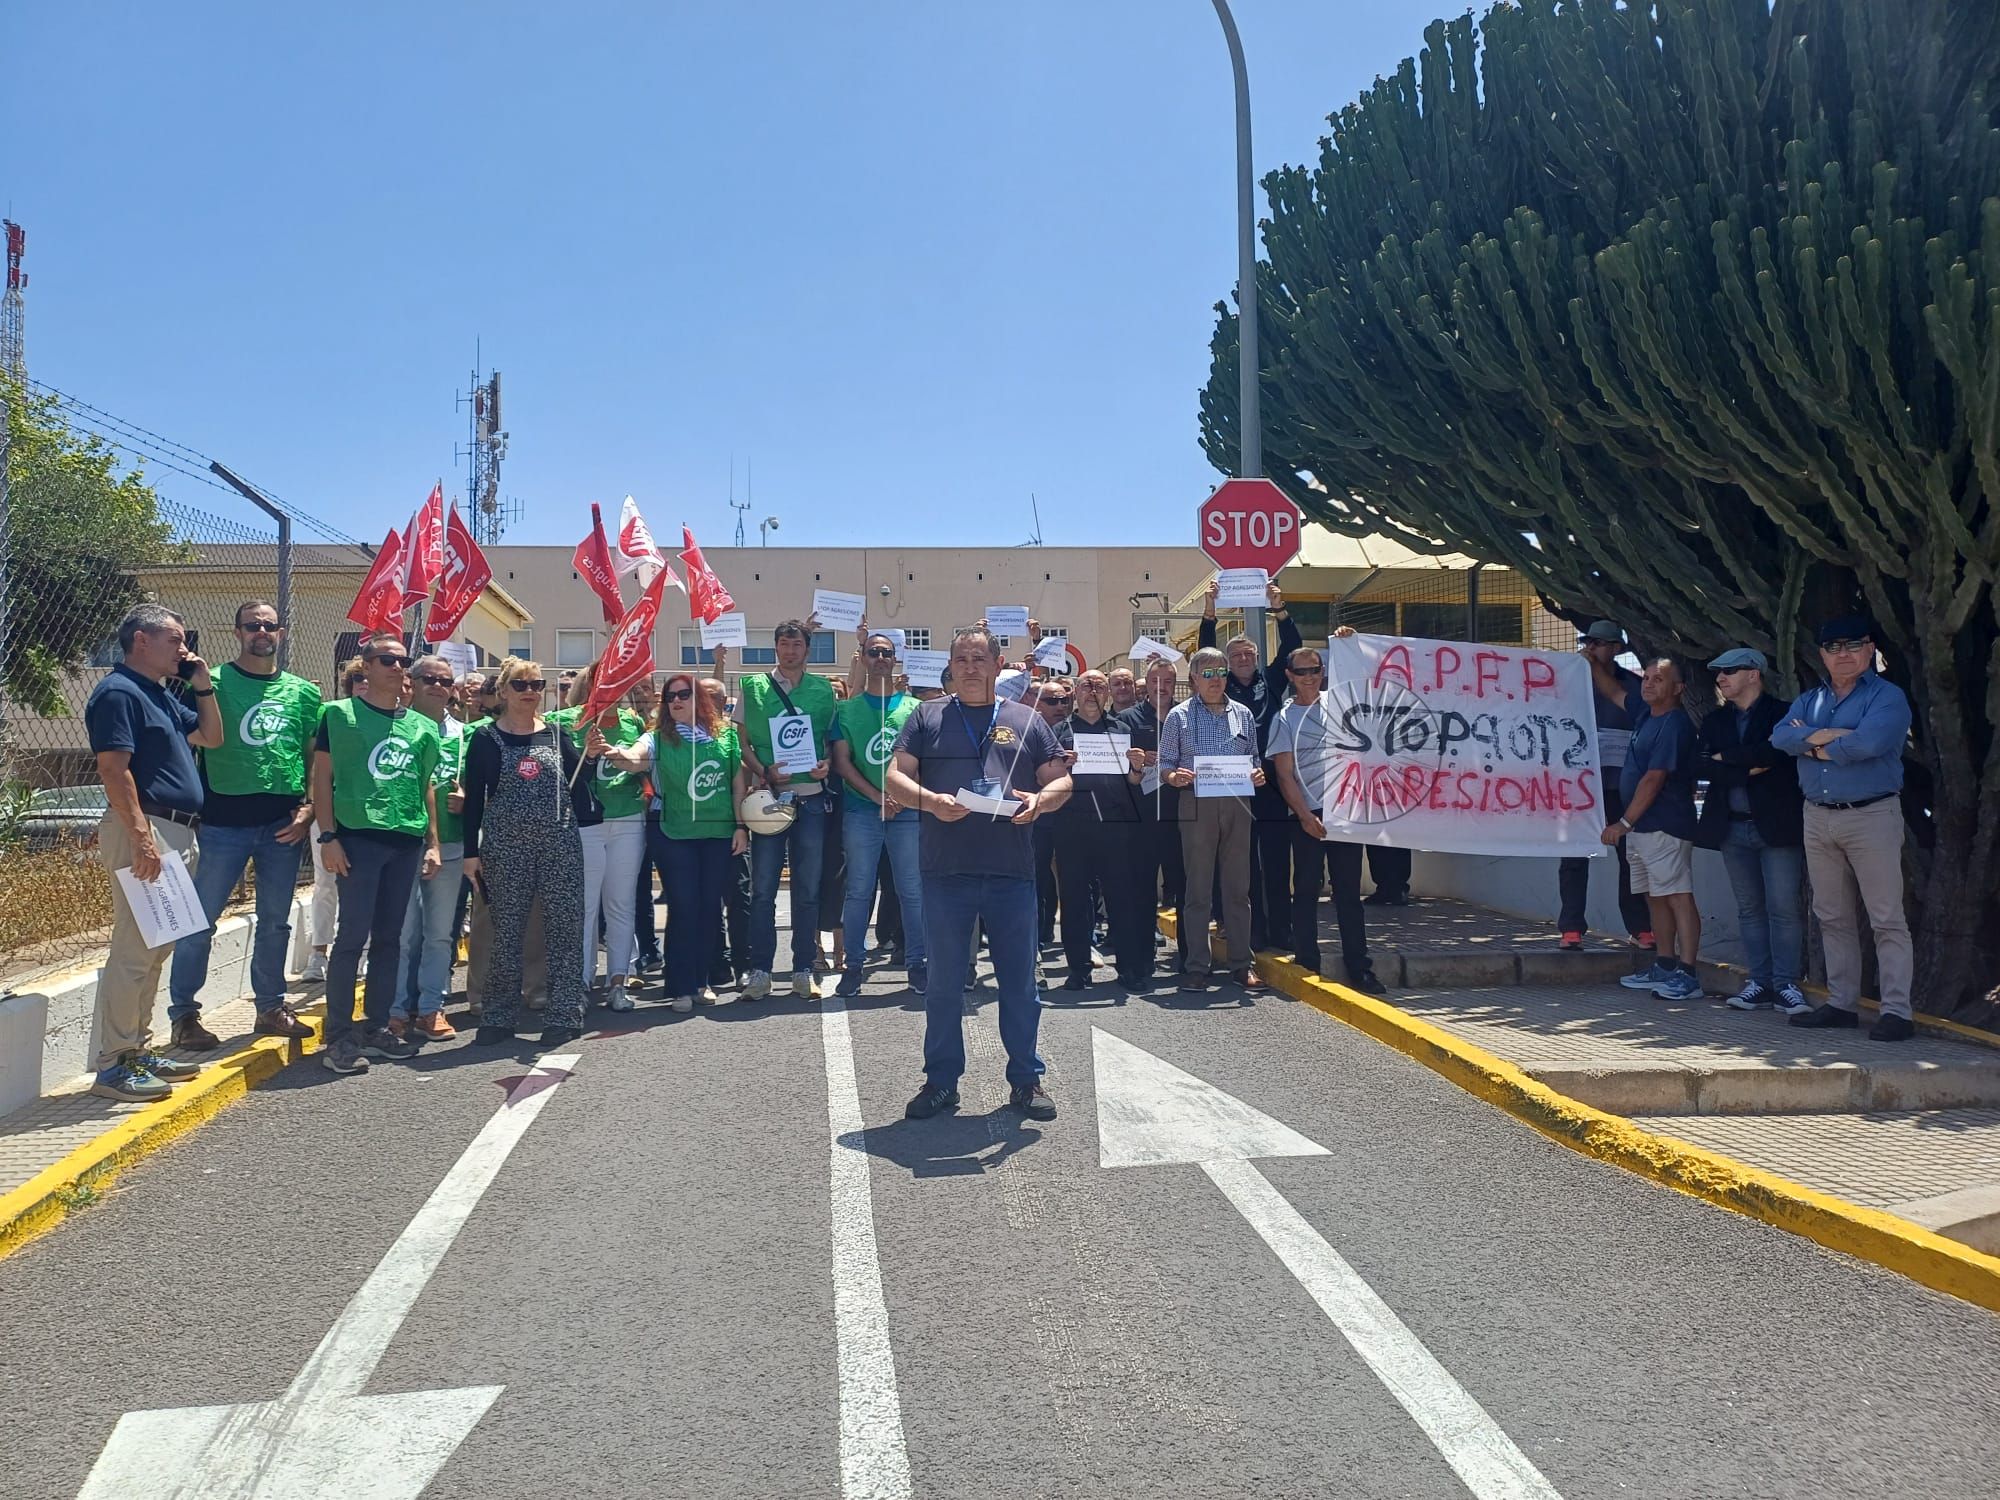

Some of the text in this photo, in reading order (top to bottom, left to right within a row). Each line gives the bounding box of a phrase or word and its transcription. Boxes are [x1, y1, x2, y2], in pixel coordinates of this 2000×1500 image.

[1206, 511, 1294, 547] STOP
[1337, 762, 1595, 812] AGRESIONES
[156, 885, 180, 931] AGRESIONES
